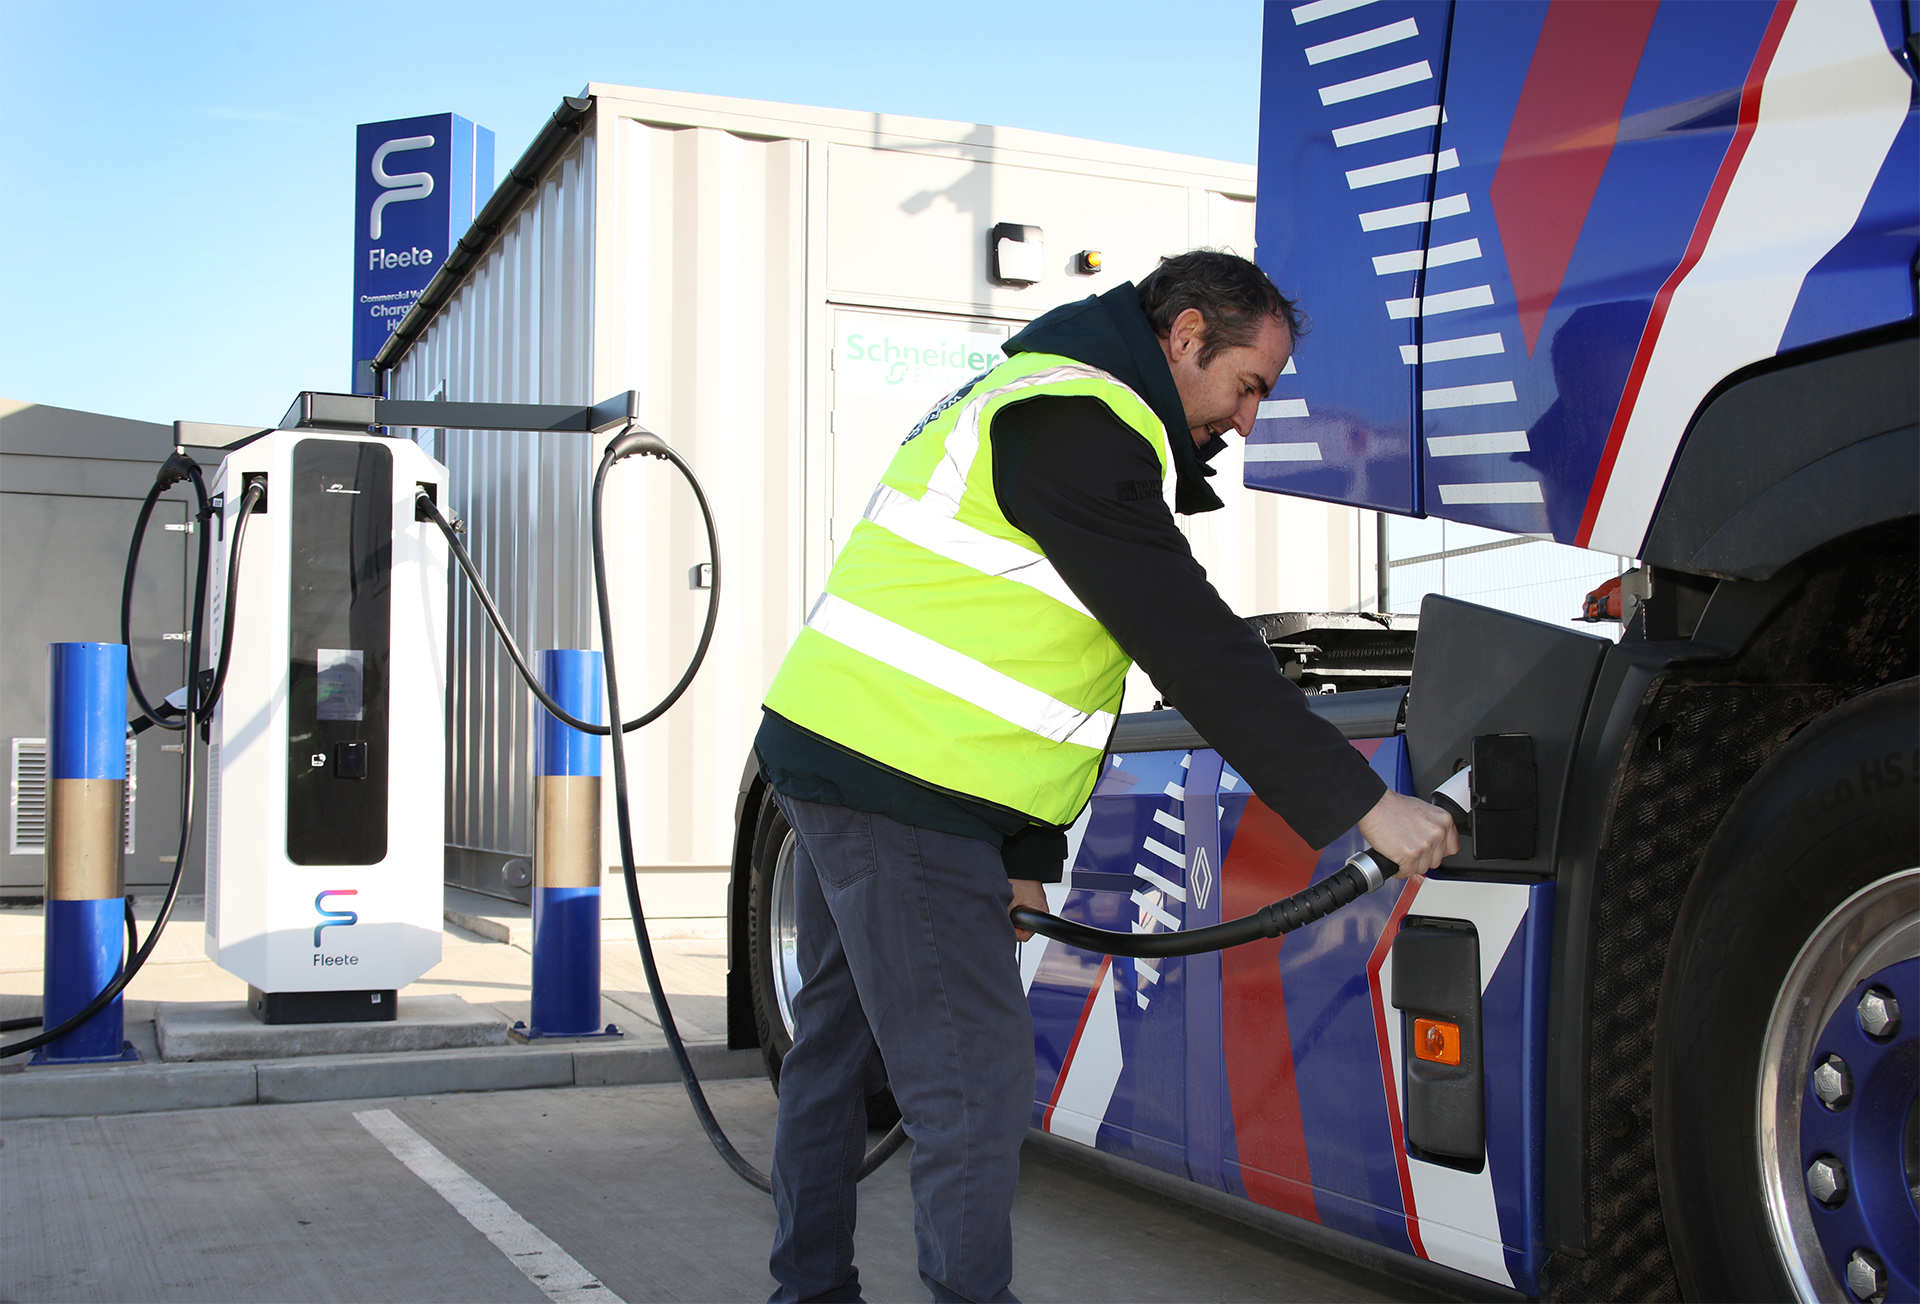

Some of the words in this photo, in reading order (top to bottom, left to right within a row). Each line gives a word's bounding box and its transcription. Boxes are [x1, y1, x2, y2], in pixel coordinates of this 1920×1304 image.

[369, 246, 433, 271] Fleete
[360, 290, 410, 304] Commercial
[846, 333, 1001, 371] Schneider
[1859, 750, 1904, 796] HS
[313, 953, 359, 967] Fleete
